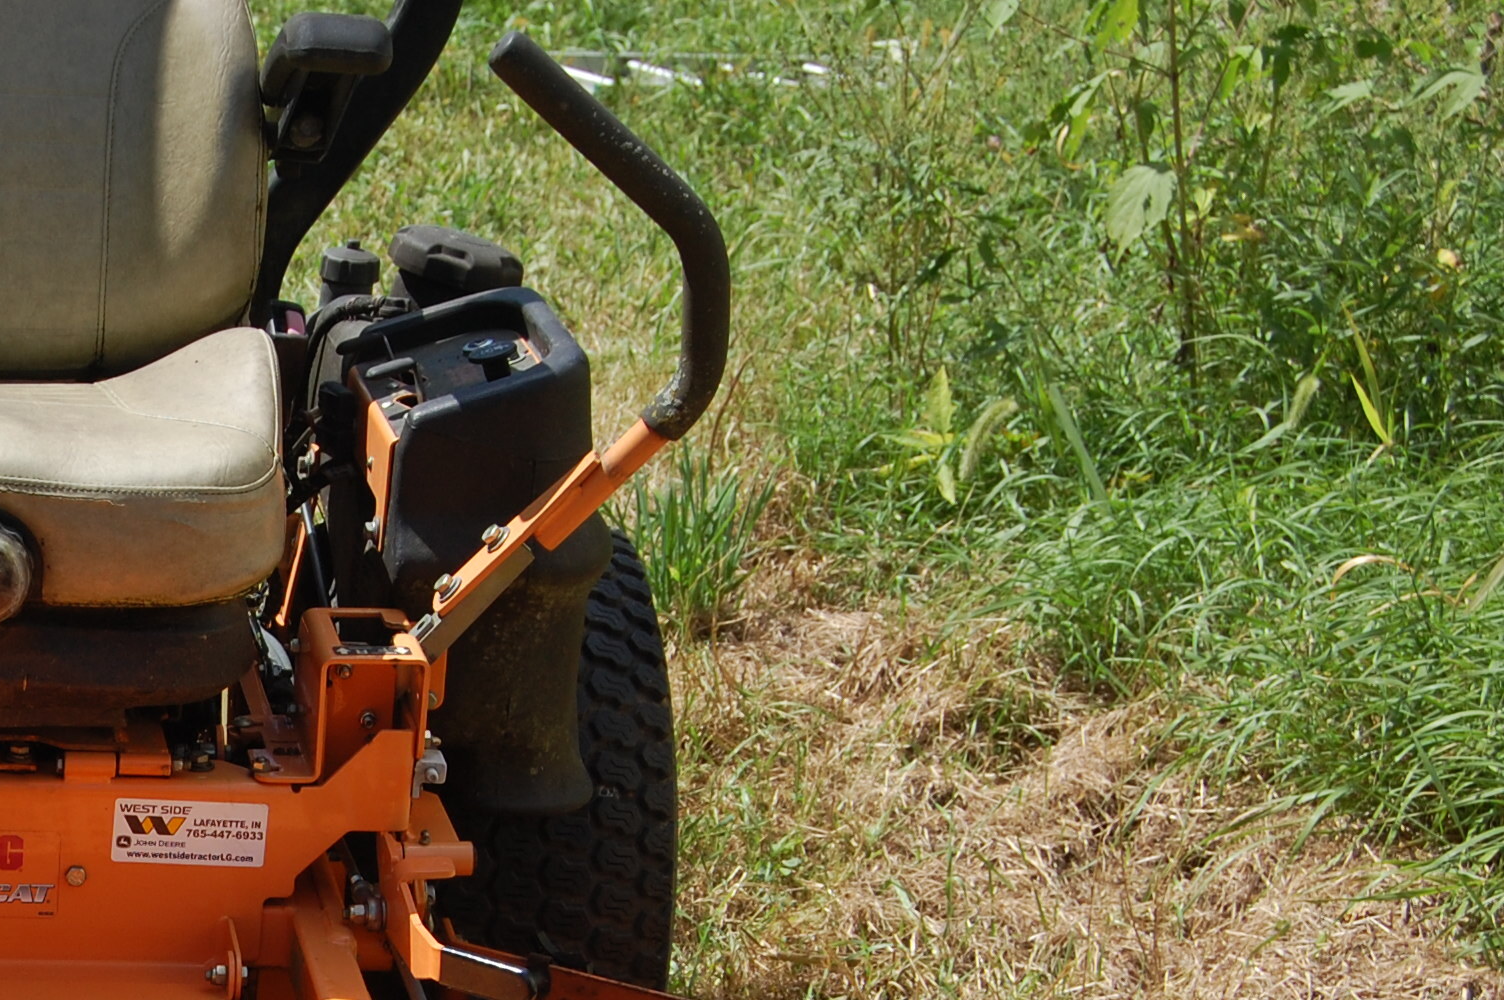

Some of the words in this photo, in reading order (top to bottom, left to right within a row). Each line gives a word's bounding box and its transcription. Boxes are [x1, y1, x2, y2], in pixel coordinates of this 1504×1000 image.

[120, 803, 157, 814] WEST
[161, 805, 192, 815] SIDE
[194, 818, 248, 829] LAFAYETTE,
[251, 820, 262, 829] IN
[186, 828, 264, 841] 765-447-6933
